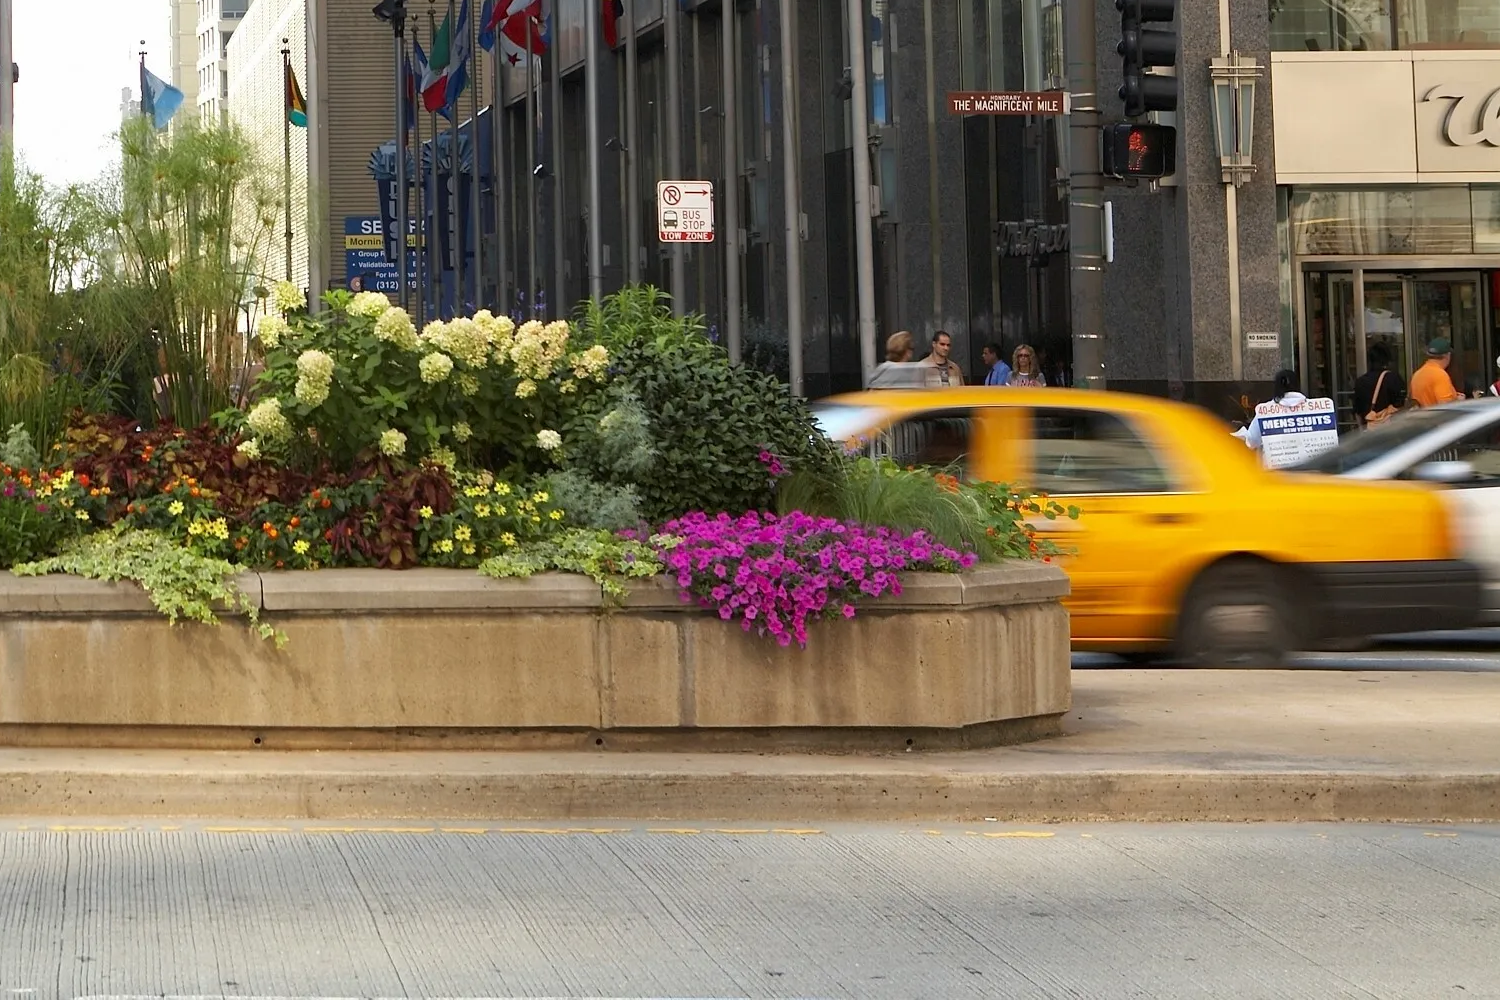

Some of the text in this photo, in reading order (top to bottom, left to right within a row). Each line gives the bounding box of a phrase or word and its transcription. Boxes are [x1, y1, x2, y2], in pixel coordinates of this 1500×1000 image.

[953, 100, 1058, 111] THE MAGNIFICENT MILE
[682, 210, 701, 220] BUS
[682, 220, 706, 230] STOP
[663, 232, 709, 240] TOW ZONE
[358, 250, 379, 259] Group
[376, 280, 399, 291] (312)
[1308, 400, 1331, 411] SALE
[1262, 415, 1332, 430] MENS SUITS
